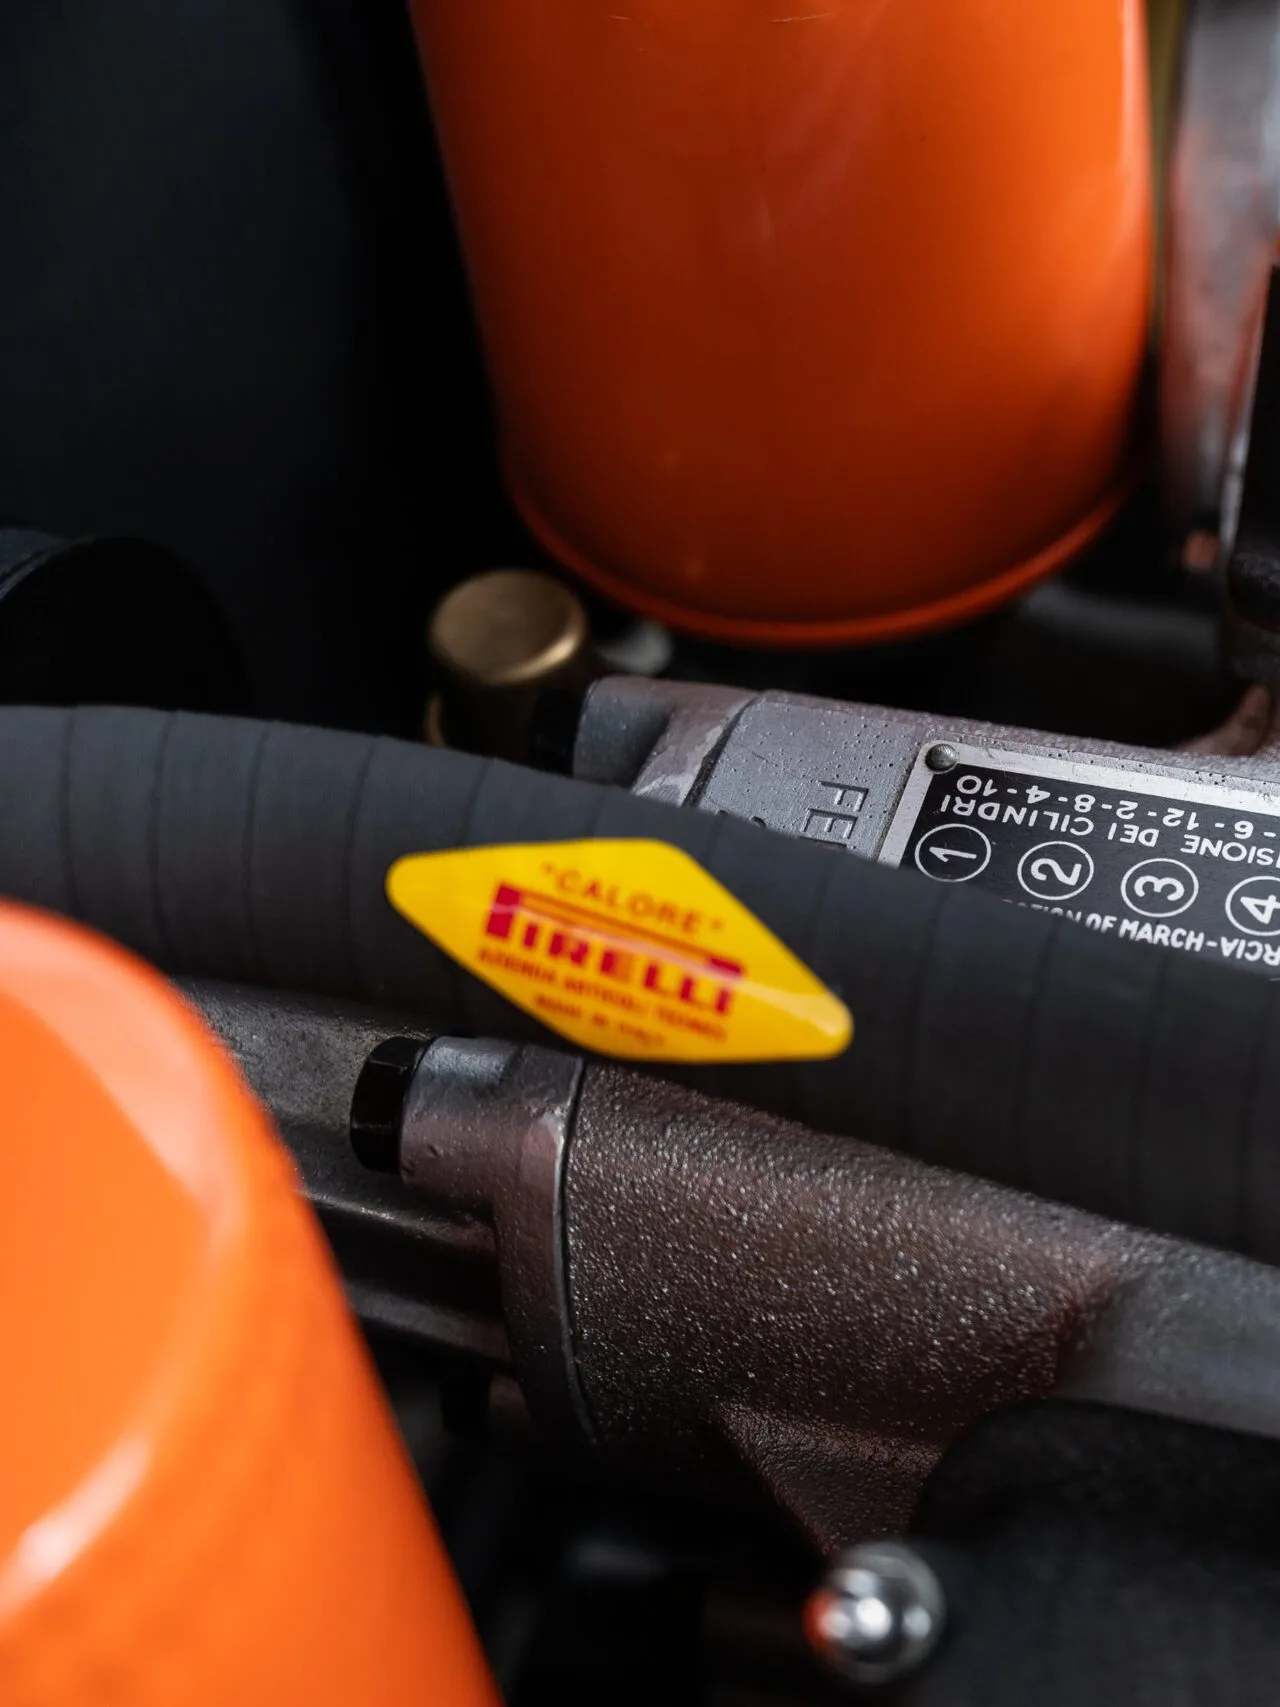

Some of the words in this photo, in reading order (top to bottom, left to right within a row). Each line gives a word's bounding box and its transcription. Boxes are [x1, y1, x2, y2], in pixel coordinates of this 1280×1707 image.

[800, 780, 869, 847] FE
[940, 794, 1094, 837] CILINDRI
[1107, 822, 1160, 848] DEI
[1030, 857, 1083, 886] 2
[1133, 874, 1186, 902] 3
[484, 880, 745, 1016] PIRELLI
